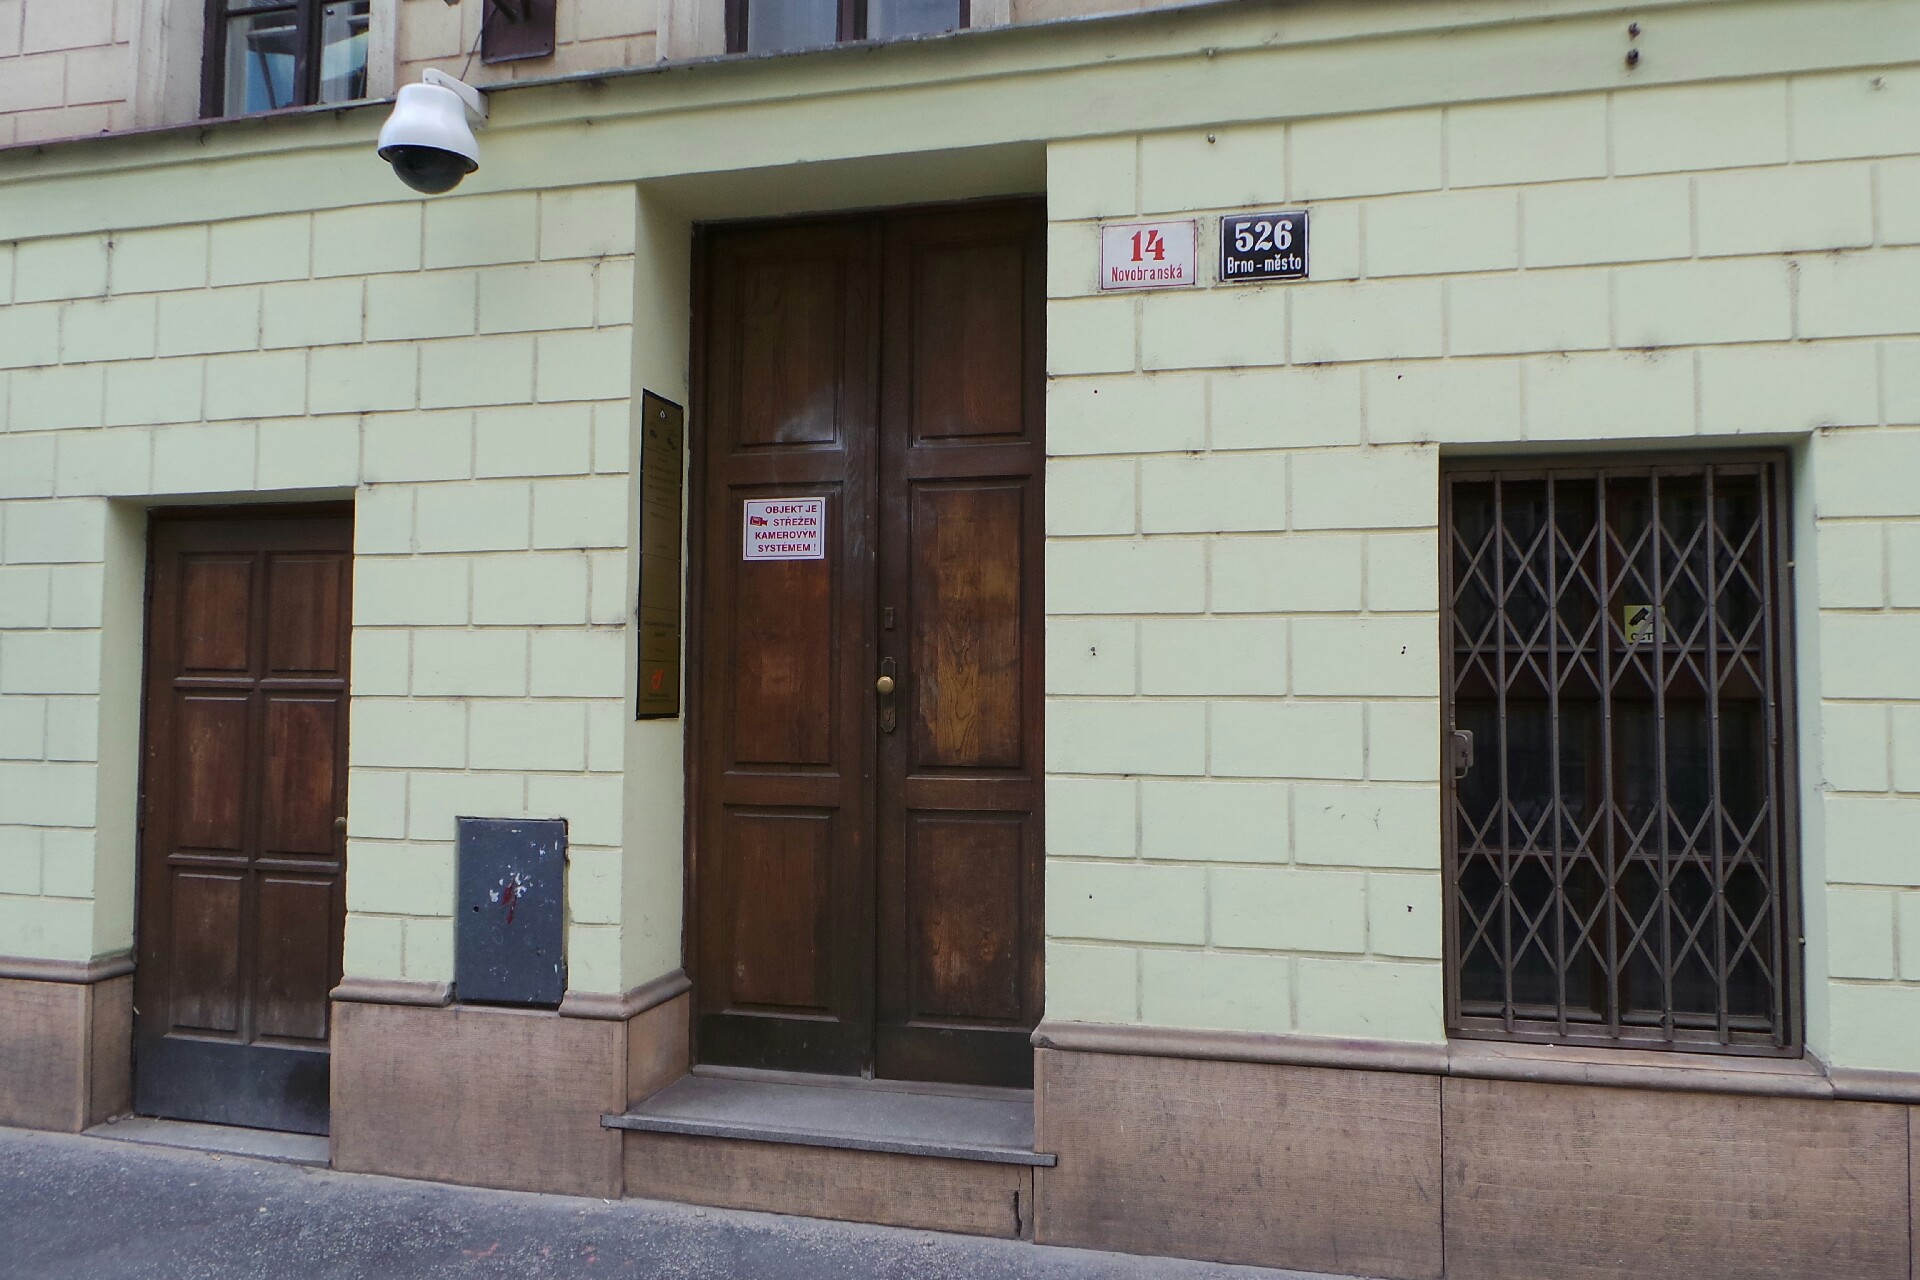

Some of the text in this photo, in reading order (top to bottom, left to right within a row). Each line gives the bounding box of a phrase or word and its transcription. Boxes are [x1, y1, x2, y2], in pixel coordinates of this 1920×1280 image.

[1235, 220, 1293, 252] 526
[1130, 229, 1165, 261] 14
[1111, 264, 1183, 282] Novobranská
[765, 505, 817, 514] OBJEKT JE
[773, 516, 817, 526] STŘEŽEN
[755, 528, 816, 540] KAMEROVÝM
[757, 542, 811, 552] SYSTÉMEM
